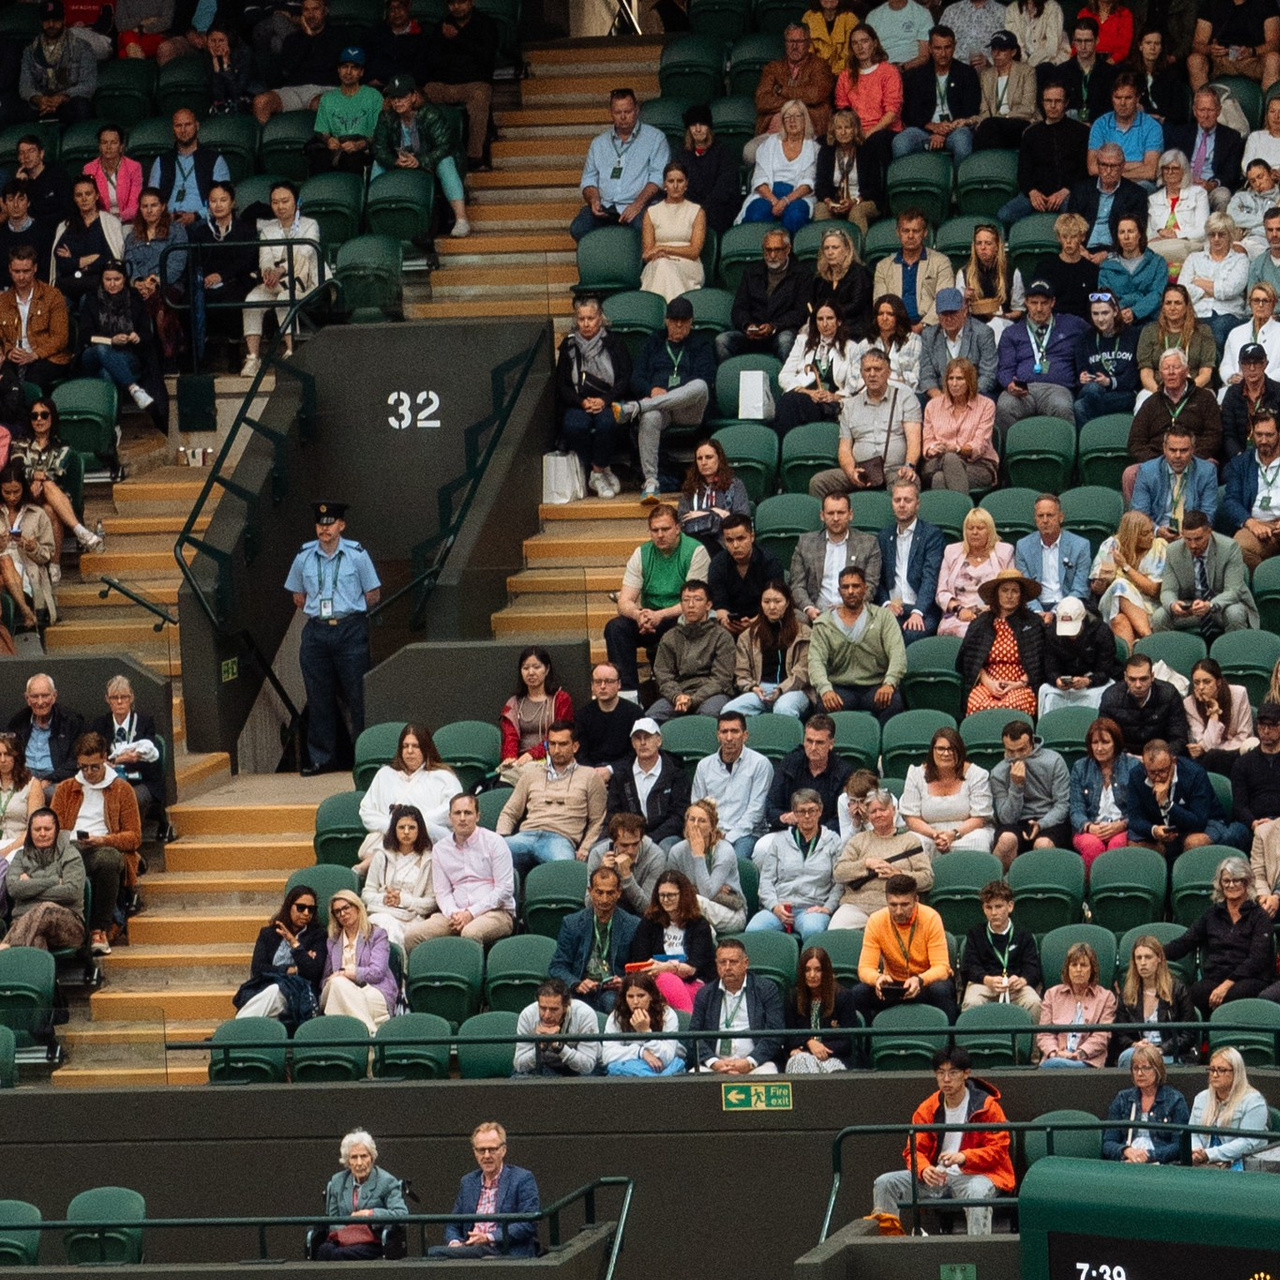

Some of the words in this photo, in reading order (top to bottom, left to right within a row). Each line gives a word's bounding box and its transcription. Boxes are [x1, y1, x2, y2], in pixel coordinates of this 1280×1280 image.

[388, 391, 440, 429] 32
[770, 1086, 788, 1096] Fire
[770, 1097, 789, 1106] exit
